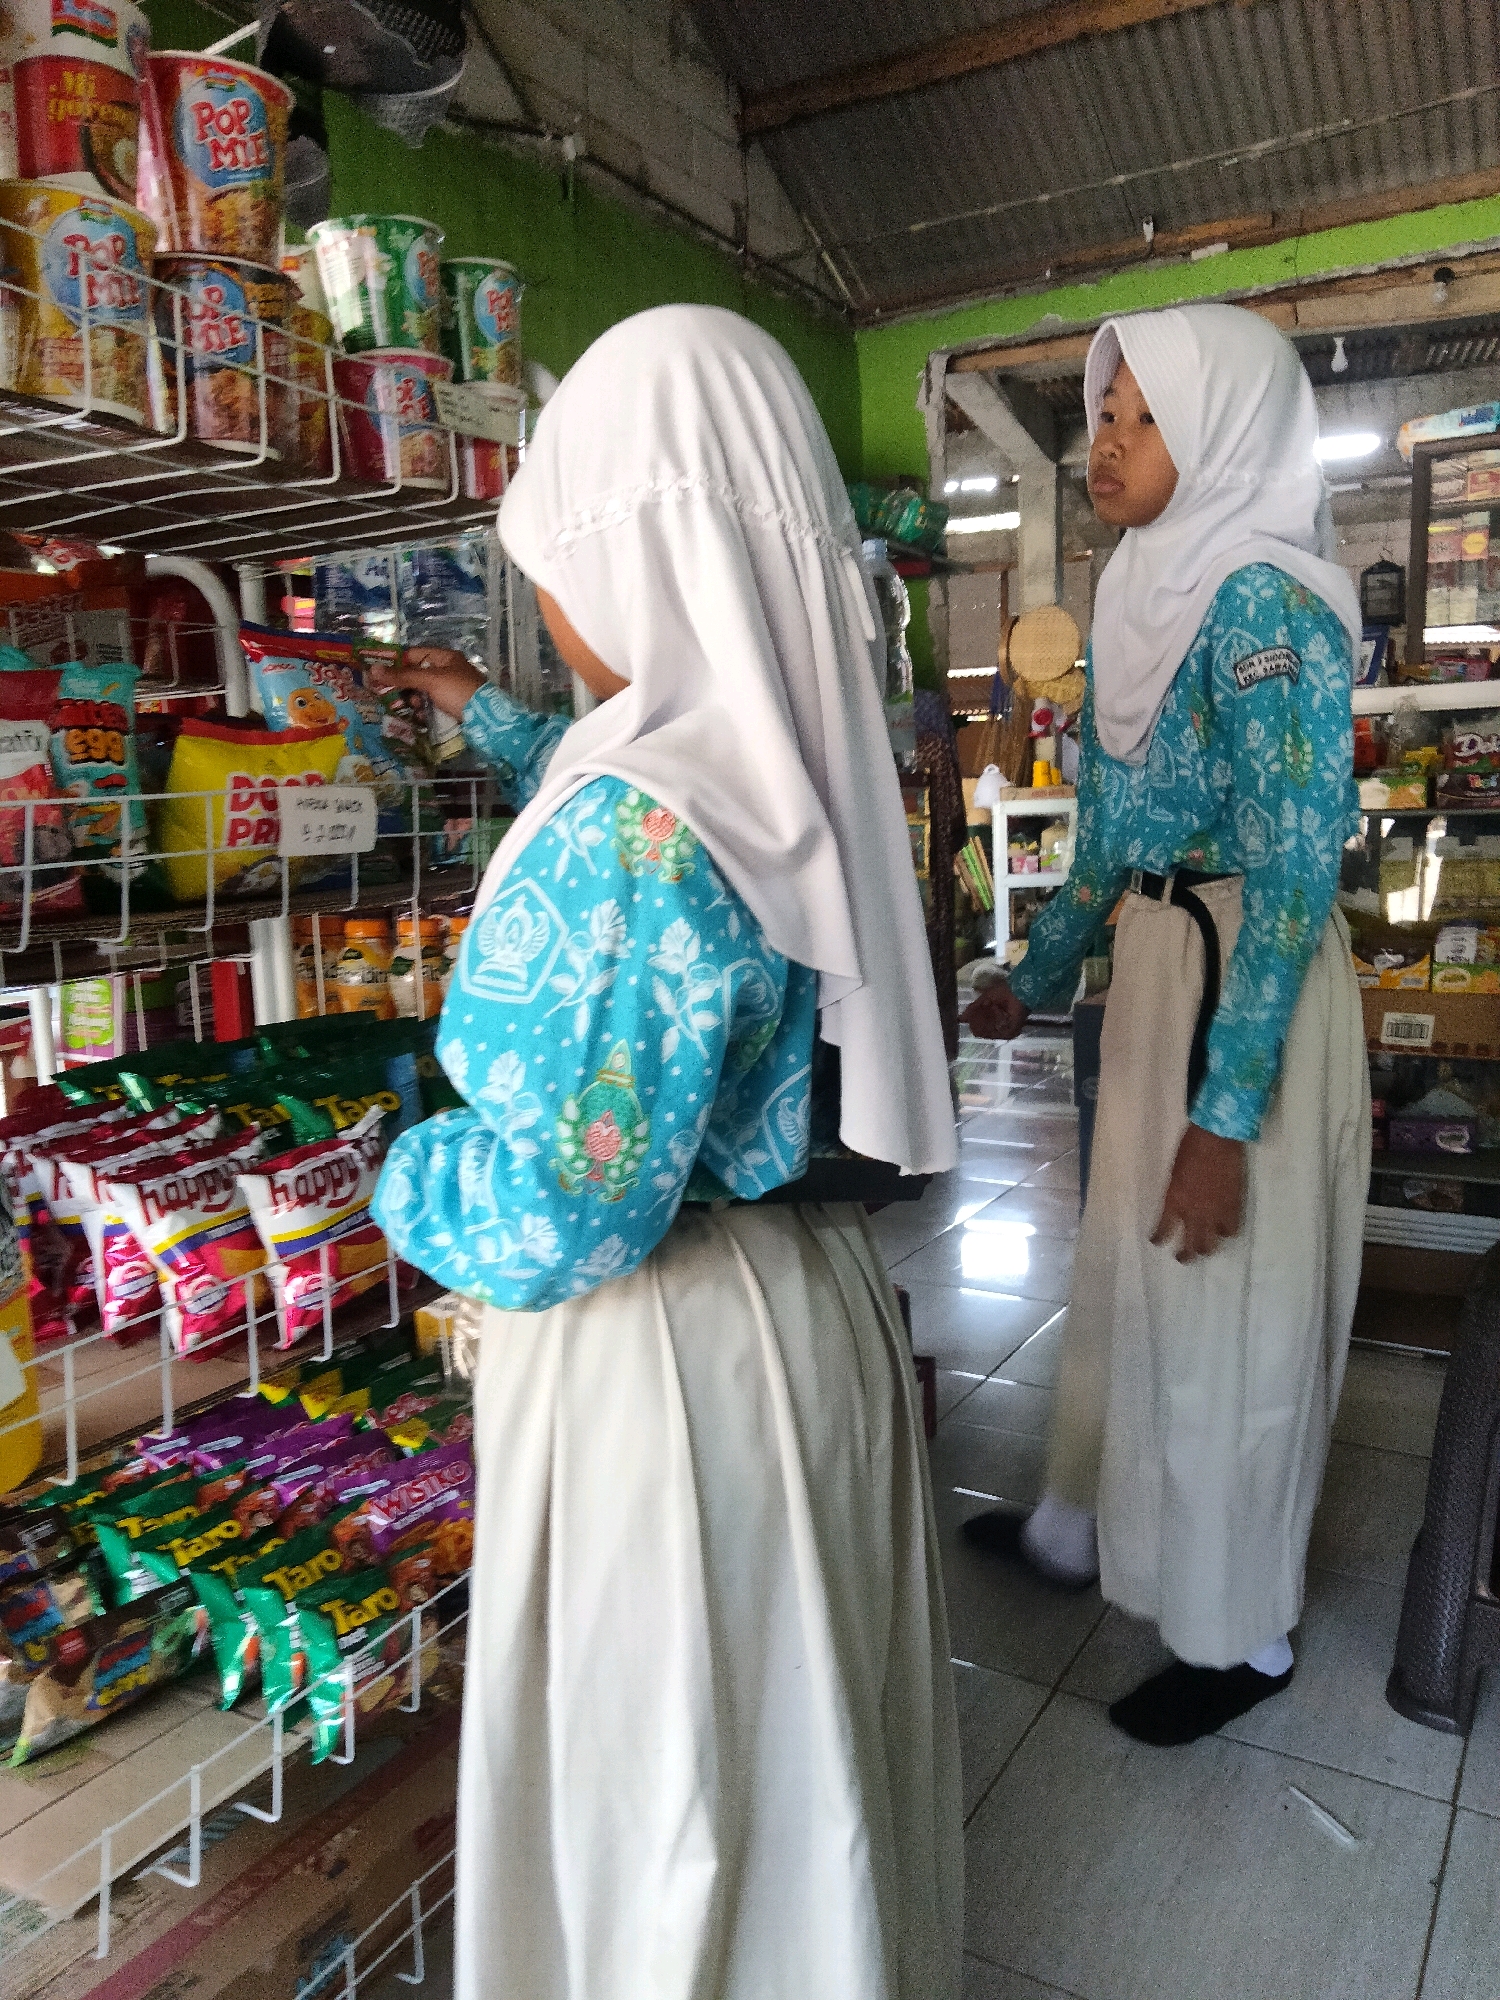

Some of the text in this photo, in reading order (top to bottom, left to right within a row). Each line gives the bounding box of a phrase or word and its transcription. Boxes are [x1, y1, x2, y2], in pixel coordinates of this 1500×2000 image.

[190, 99, 251, 142] POP
[63, 233, 126, 277] POP
[268, 1153, 361, 1214] happy
[262, 1548, 344, 1601] Taro
[319, 1586, 400, 1636] Taro
